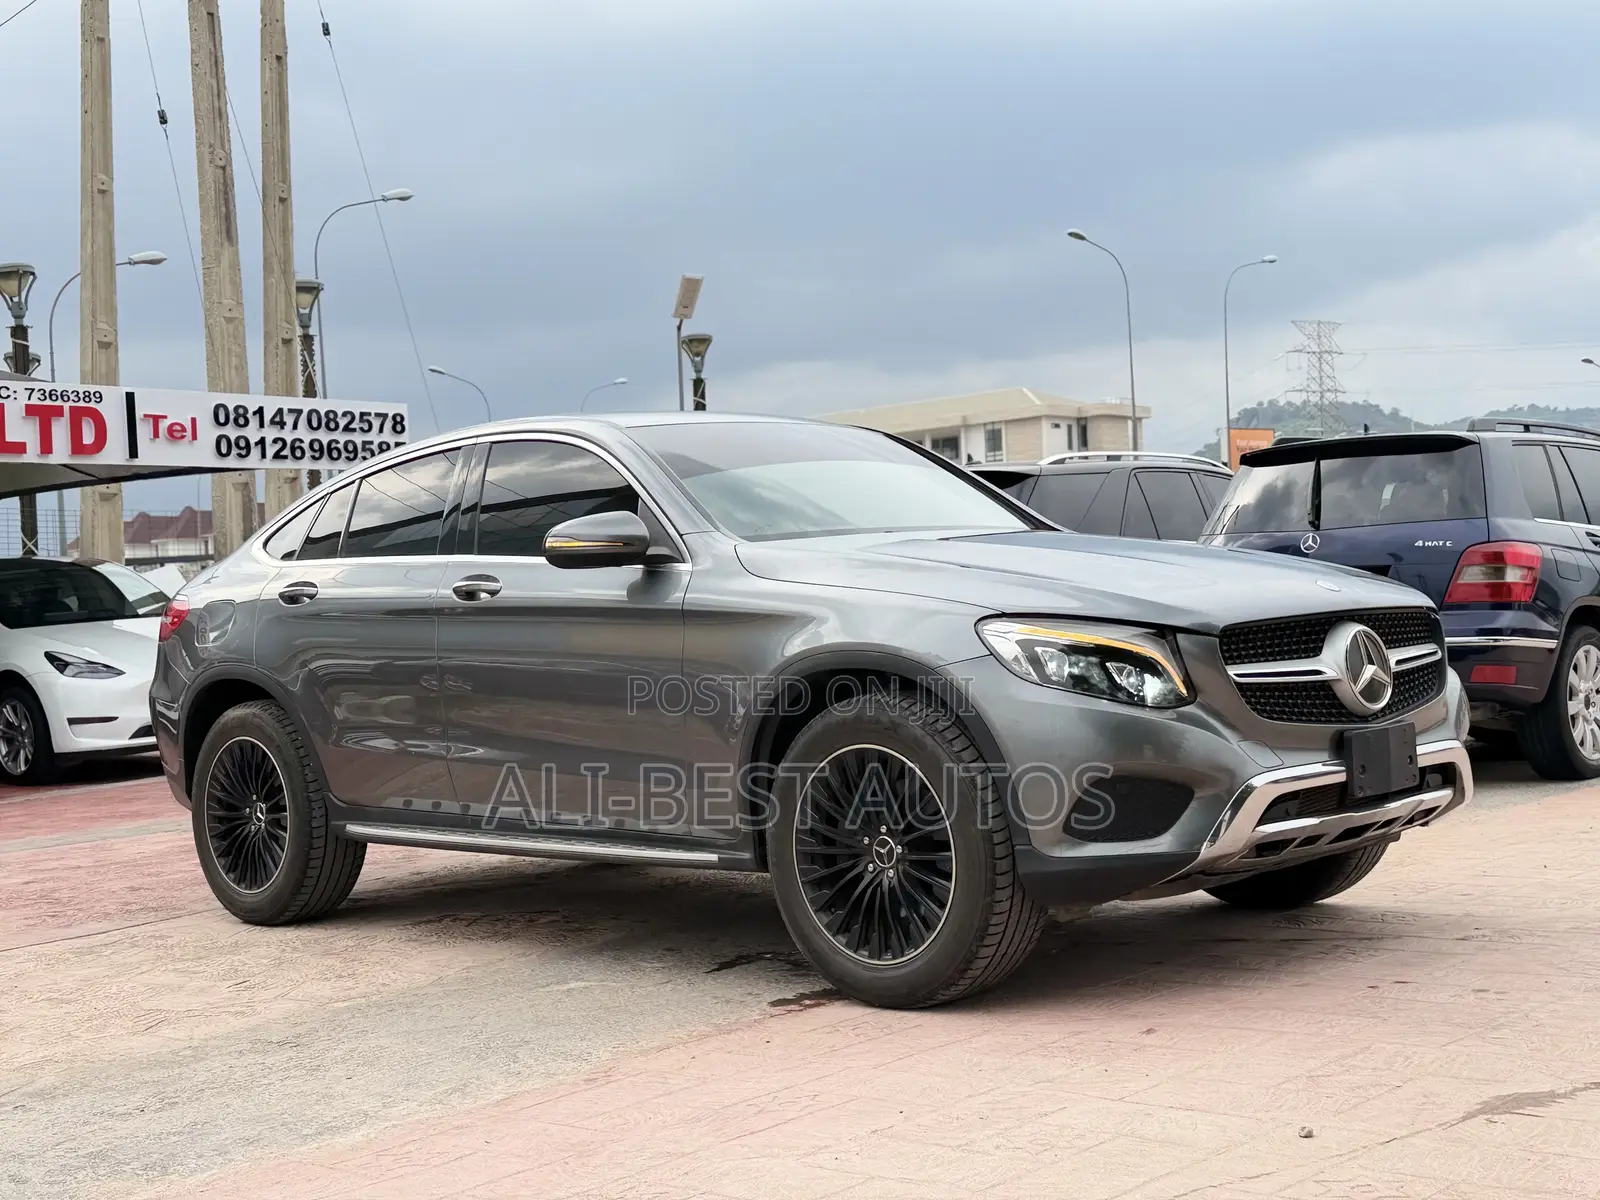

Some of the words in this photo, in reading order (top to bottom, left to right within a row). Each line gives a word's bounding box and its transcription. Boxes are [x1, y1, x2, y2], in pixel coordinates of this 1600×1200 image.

[24, 387, 103, 404] 7366389
[0, 402, 108, 456] LTD
[142, 413, 197, 442] Tel
[213, 402, 406, 434] 08147082578
[215, 433, 406, 461] 0912696958
